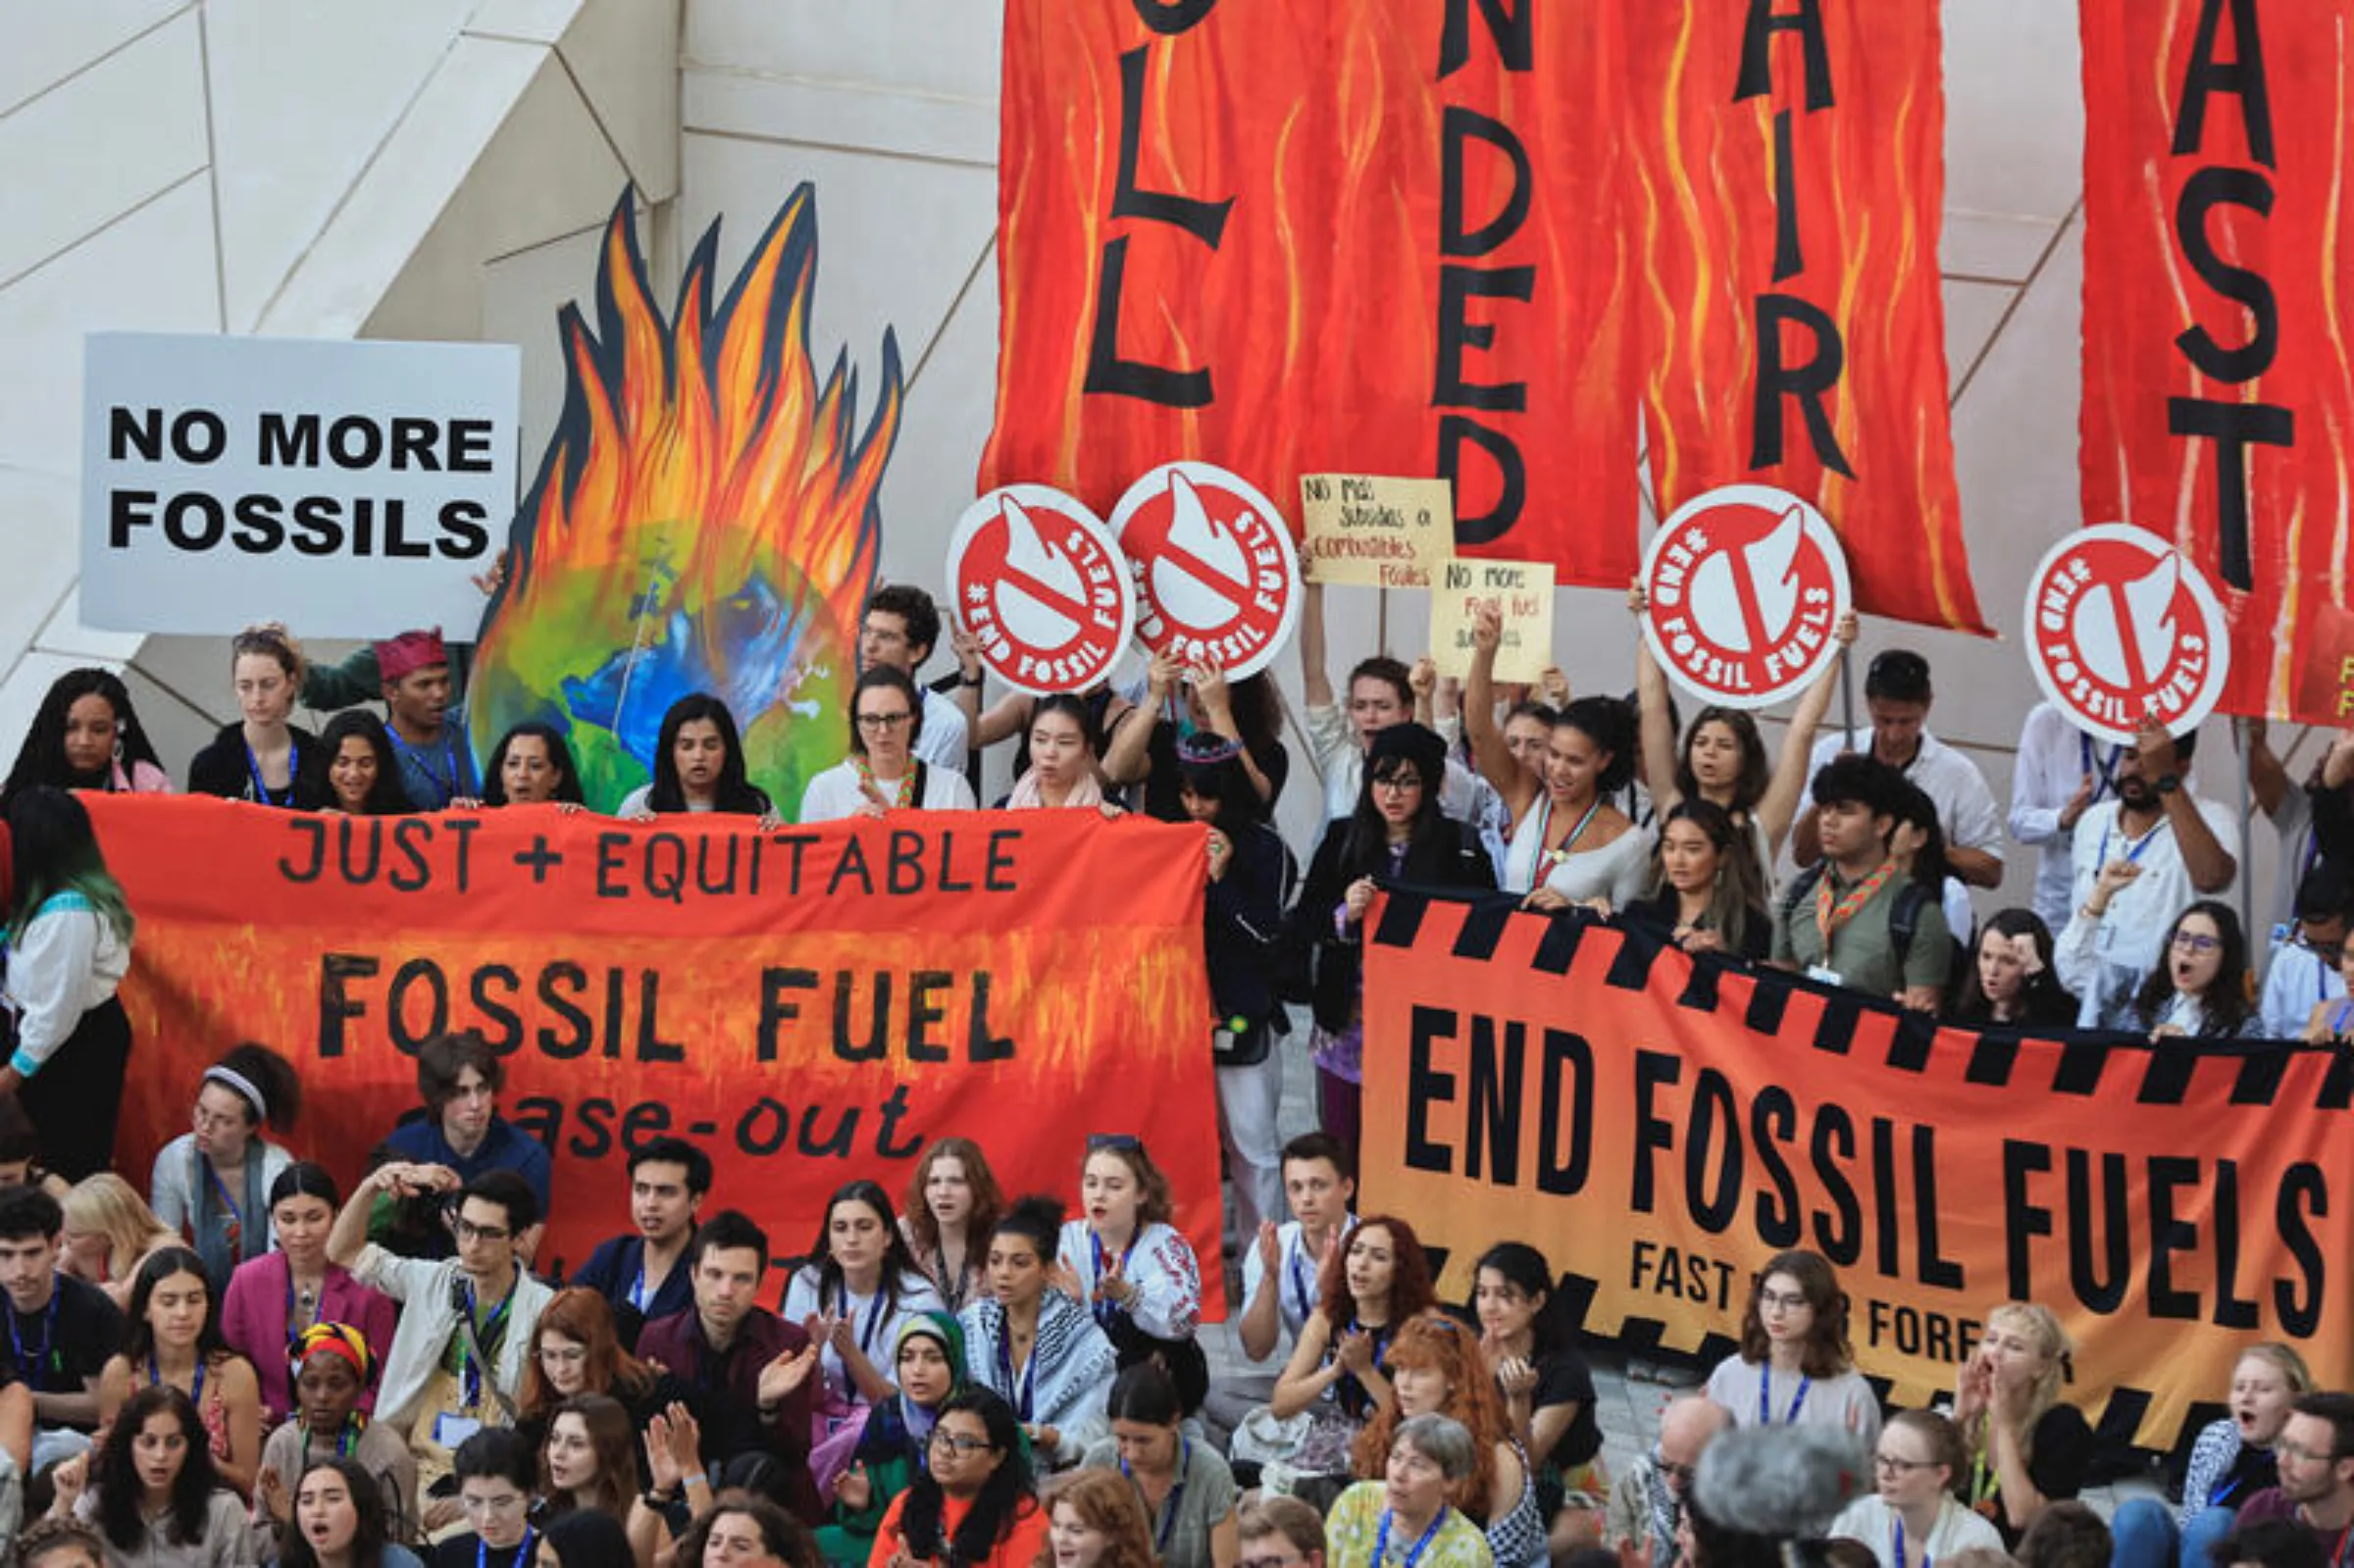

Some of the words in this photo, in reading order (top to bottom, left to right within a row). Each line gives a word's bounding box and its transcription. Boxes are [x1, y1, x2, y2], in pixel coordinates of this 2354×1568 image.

[109, 407, 227, 464] NO
[258, 413, 493, 473] MORE
[109, 489, 490, 560] FOSSILS
[1233, 510, 1284, 614] FUELS
[1017, 639, 1106, 683] FOSSIL
[1066, 531, 1117, 630] FUELS
[1655, 527, 1709, 607] #END
[2040, 557, 2093, 632] #END
[1662, 616, 1752, 689] FOSSIL
[1765, 586, 1829, 683] FUELS
[2142, 633, 2205, 715] FUELS
[2046, 642, 2133, 725] FOSSIL
[279, 816, 481, 894] JUST
[596, 828, 1024, 905] EQUITABLE
[318, 953, 684, 1063] FOSSIL
[756, 965, 1015, 1063] FUEL
[1405, 1004, 1594, 1195] END
[1630, 1048, 1966, 1290] FOSSIL
[2003, 1138, 2329, 1340] FUELS
[1630, 1240, 1735, 1311] FAST
